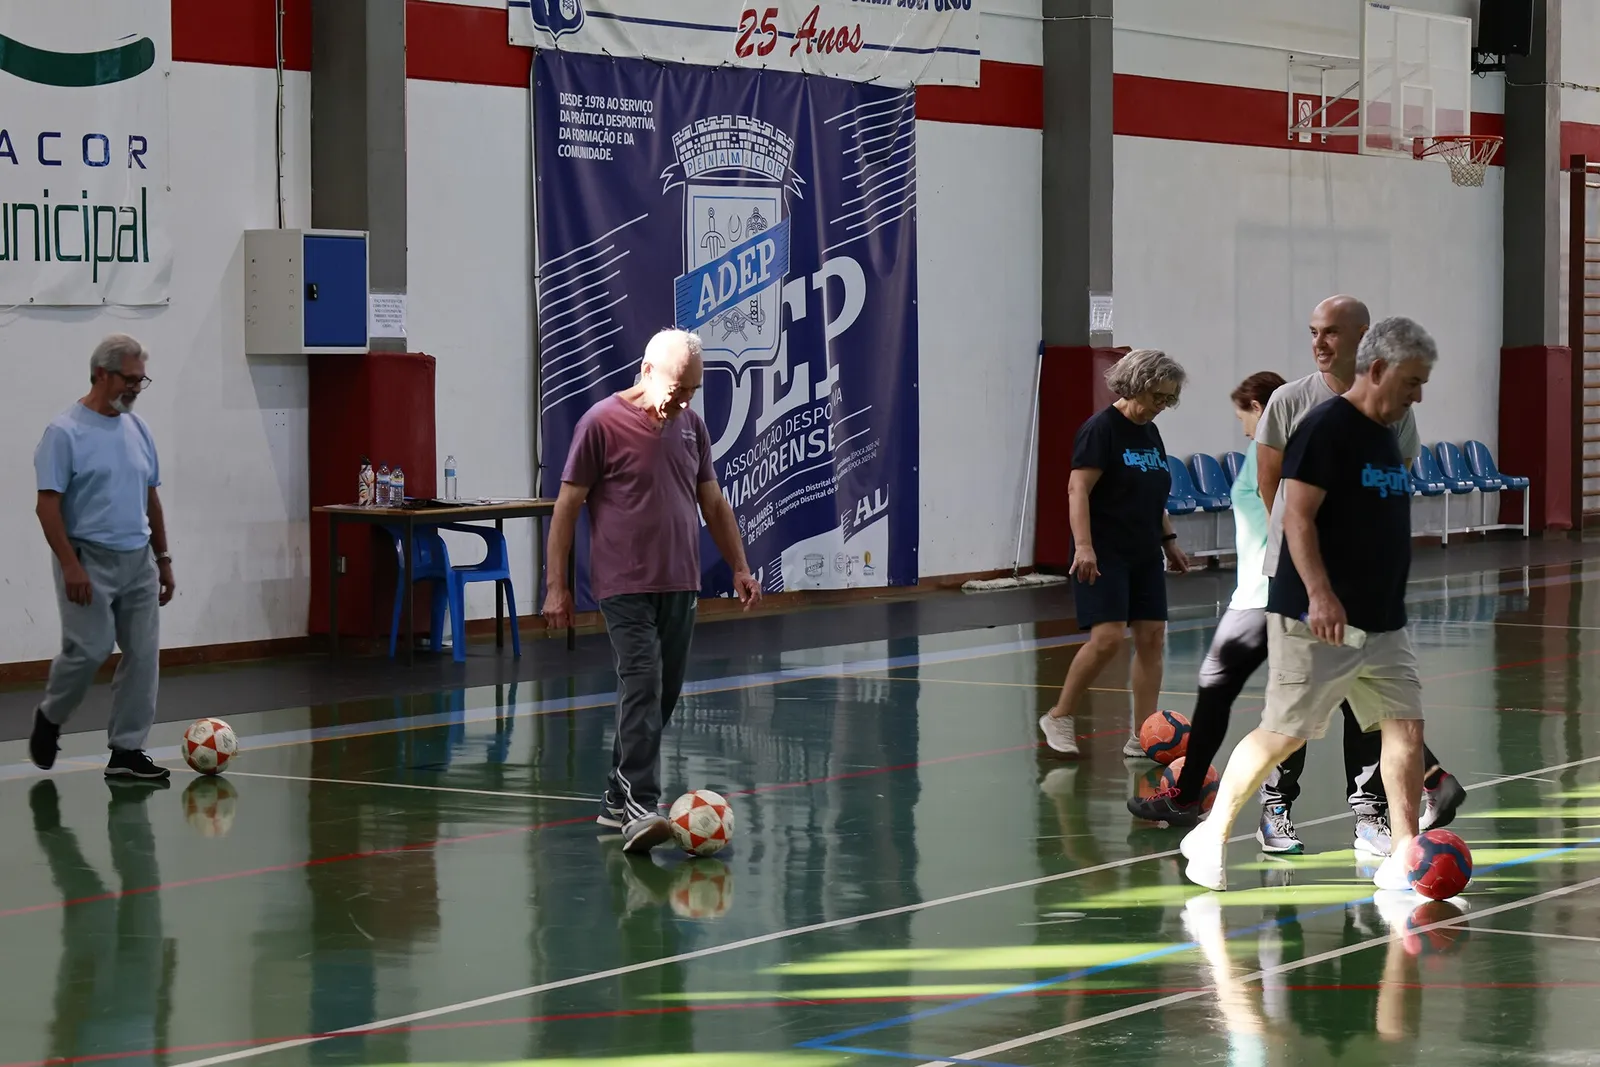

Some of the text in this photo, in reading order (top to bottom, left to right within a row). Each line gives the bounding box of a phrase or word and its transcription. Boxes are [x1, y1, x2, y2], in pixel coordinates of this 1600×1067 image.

[735, 5, 863, 58] 25 Anos
[559, 92, 653, 116] DESDE 1978 AO SERVIÇO
[559, 109, 656, 132] DA PRÁTICA DESPORTIVA,
[558, 144, 613, 160] COMUNIDADE.
[559, 127, 635, 146] DA FORMAÇÃO E DA
[686, 152, 784, 176] PENAMACOR
[696, 238, 776, 319] ADEP
[724, 424, 782, 480] ASSOCIAÇÃO
[747, 501, 774, 532] PALMARÉS
[805, 478, 831, 493] Distrital
[747, 531, 756, 546] DE
[801, 489, 826, 504] Distrital
